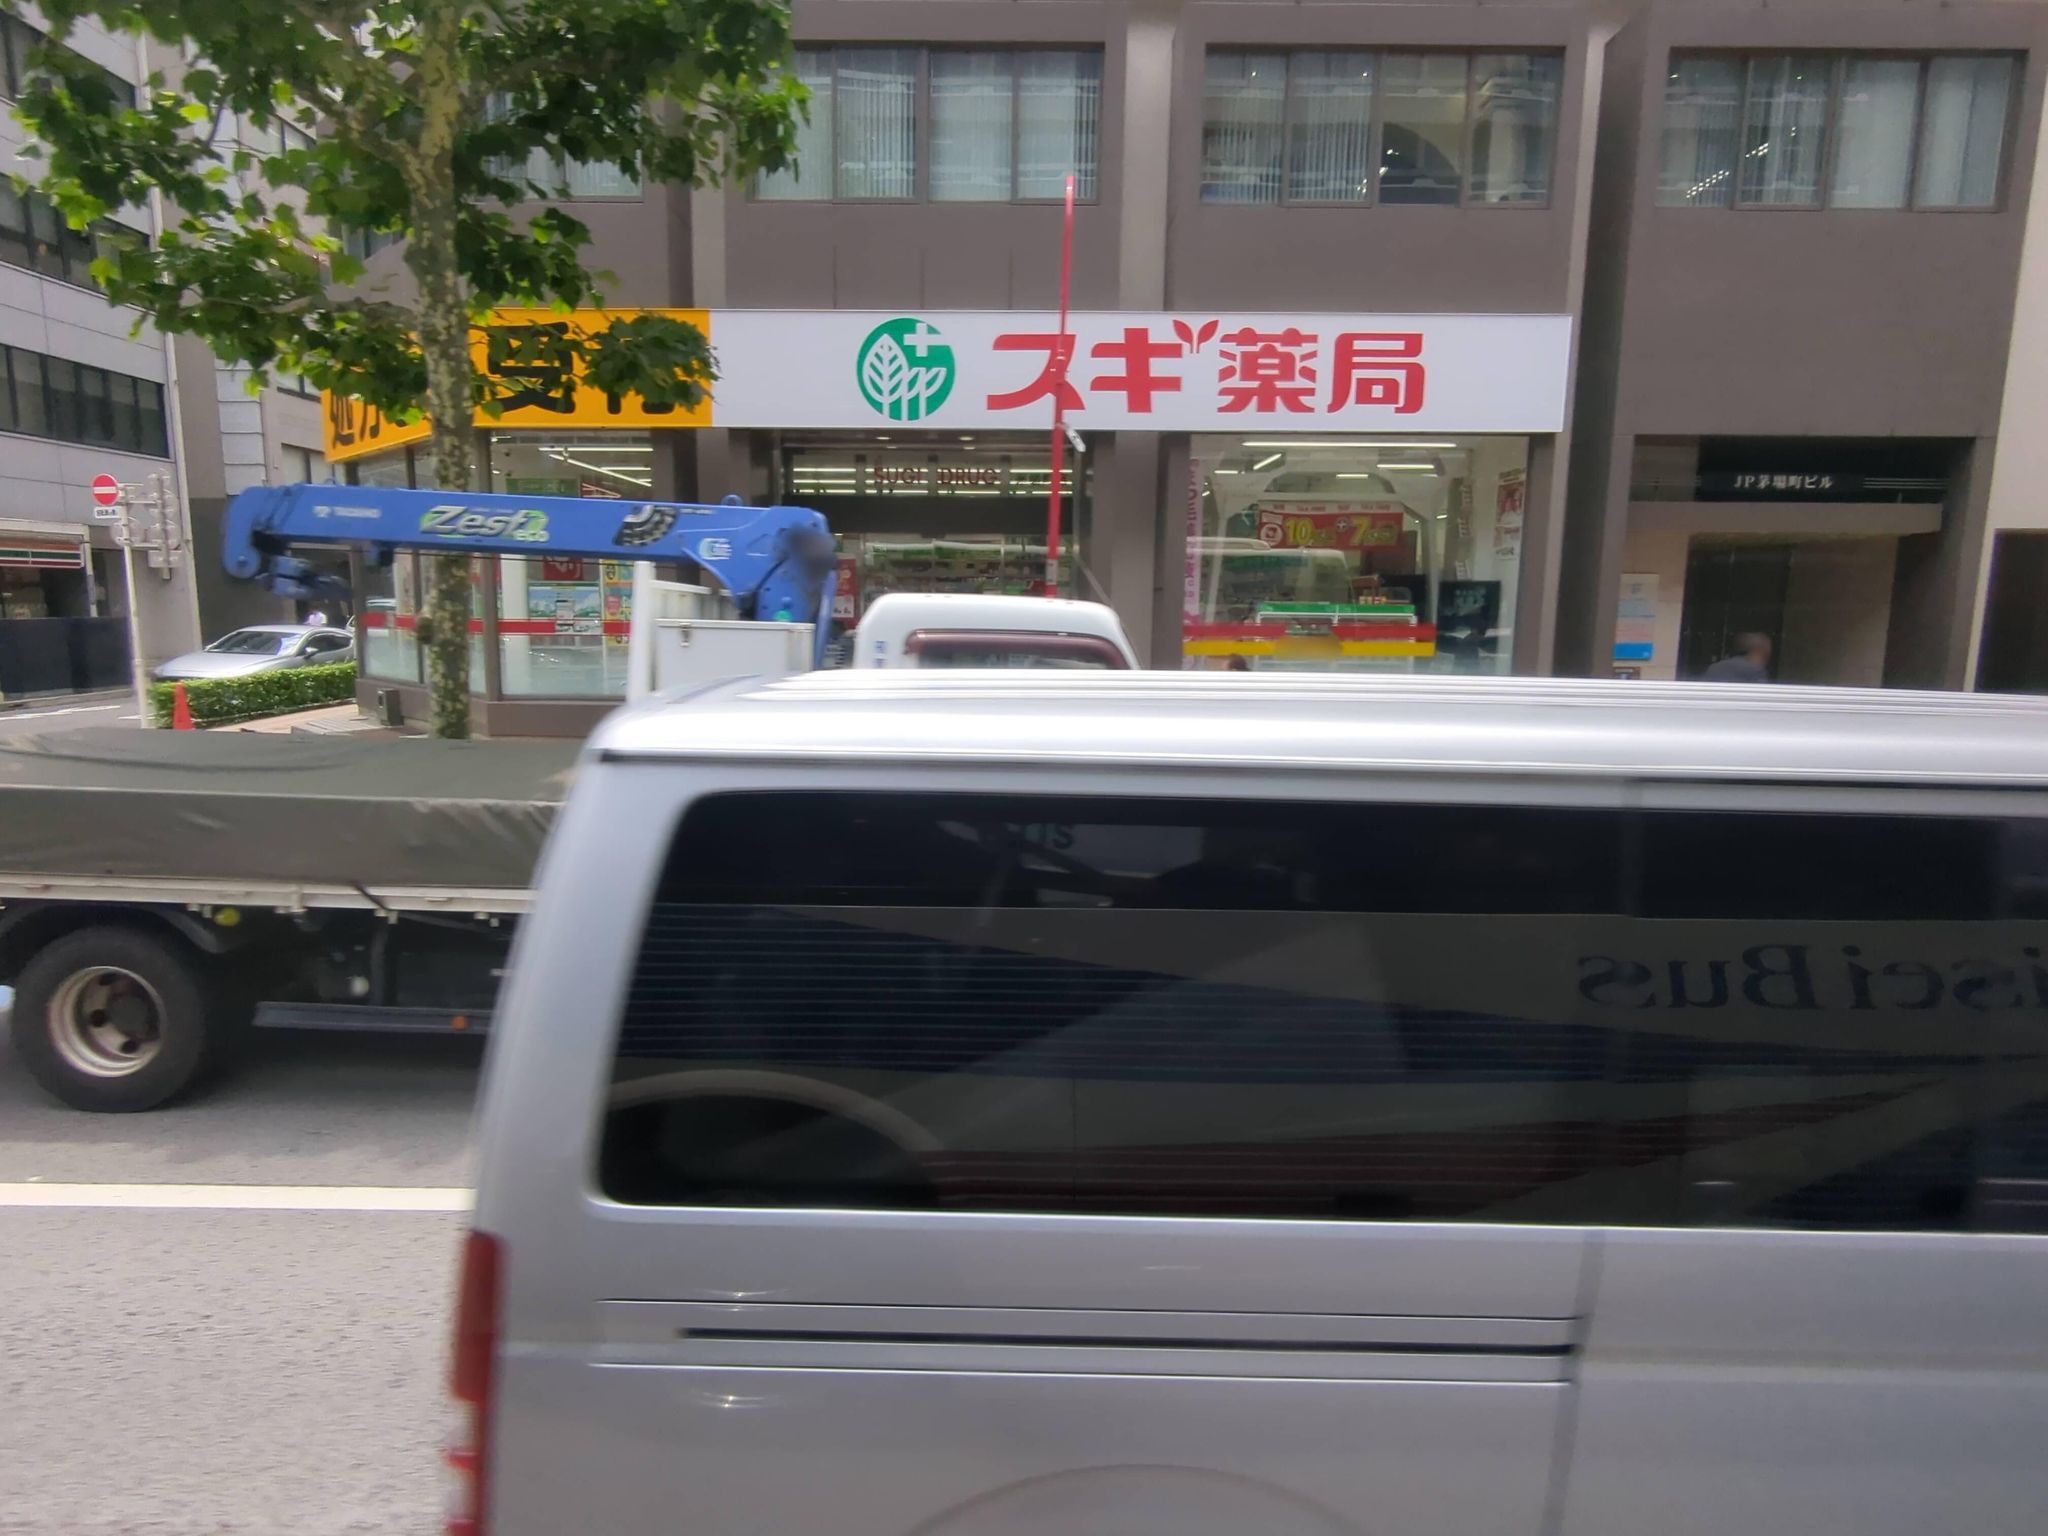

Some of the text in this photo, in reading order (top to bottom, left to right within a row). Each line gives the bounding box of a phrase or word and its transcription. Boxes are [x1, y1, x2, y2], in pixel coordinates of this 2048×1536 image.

[986, 319, 1426, 415] スギ薬局
[874, 467, 923, 484] SUGI
[939, 467, 998, 485] DRUG
[421, 505, 530, 536] Zest
